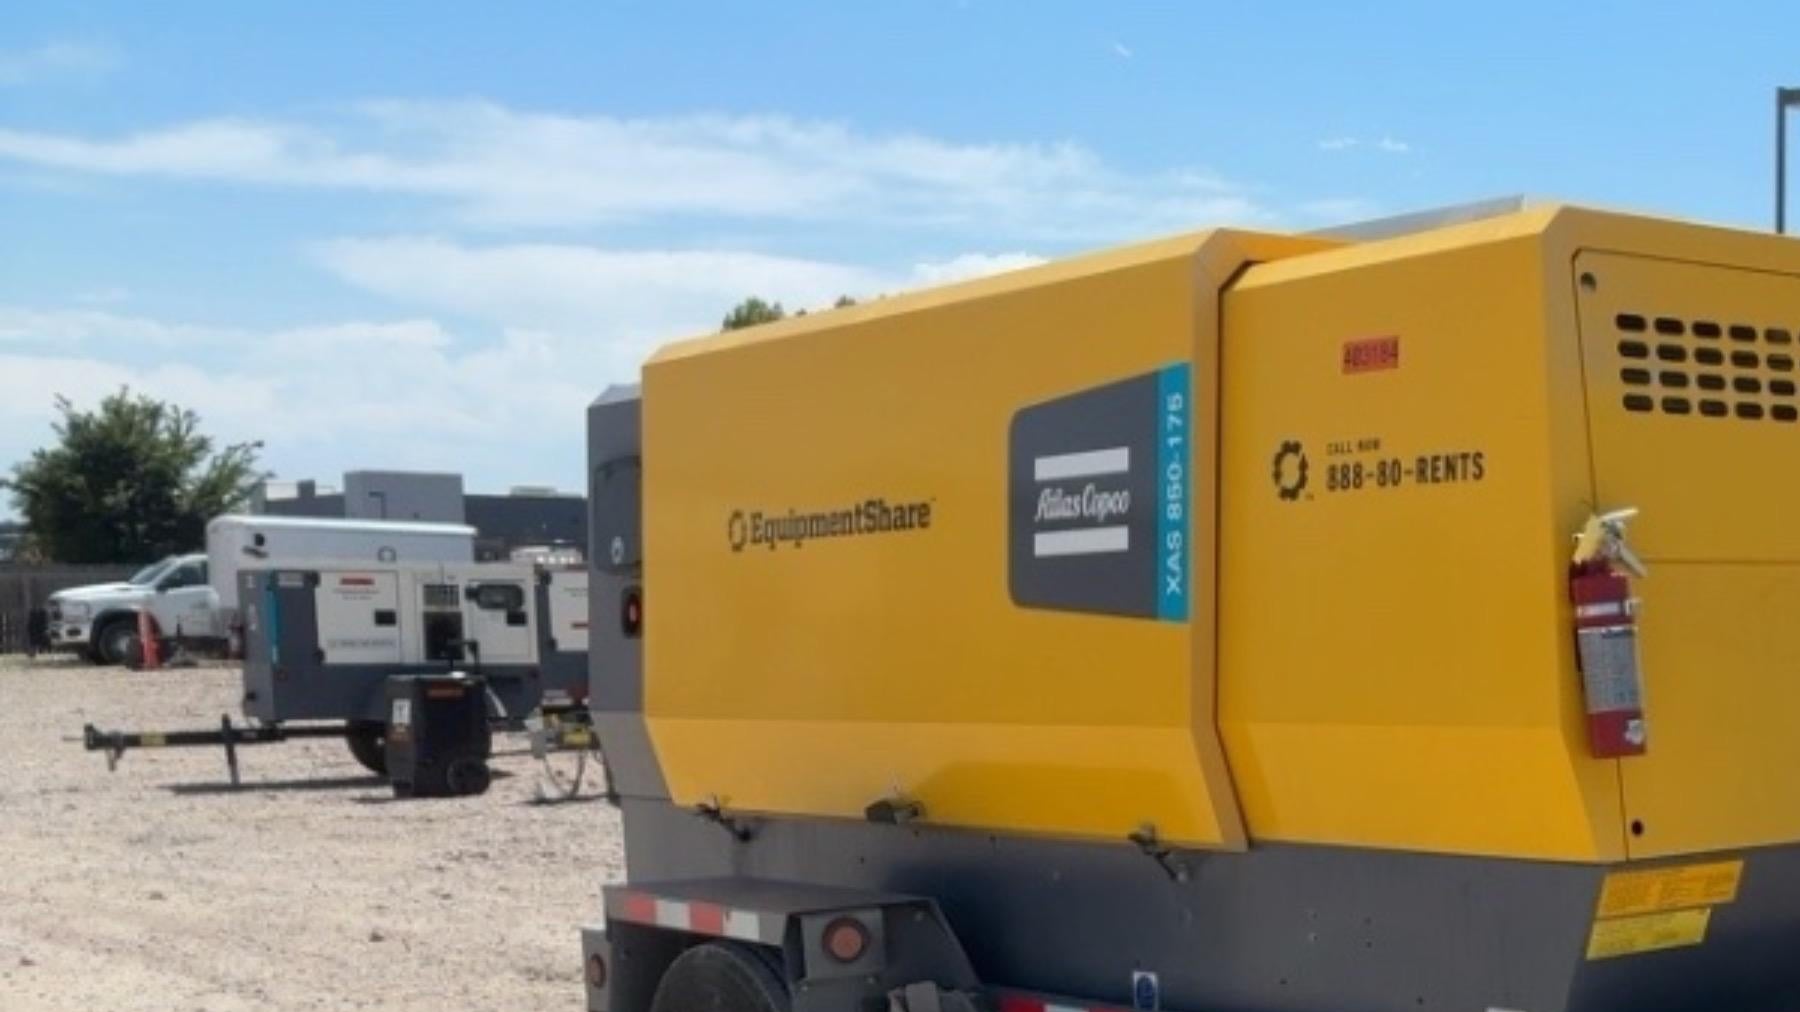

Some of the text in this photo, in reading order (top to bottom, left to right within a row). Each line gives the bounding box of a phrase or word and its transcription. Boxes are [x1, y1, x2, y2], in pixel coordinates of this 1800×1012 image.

[1166, 392, 1183, 595] XAS 850-175
[1326, 450, 1485, 492] 888-80-RENTS
[750, 498, 932, 551] EquipmentShare
[1034, 482, 1130, 522] Atlas Copco
